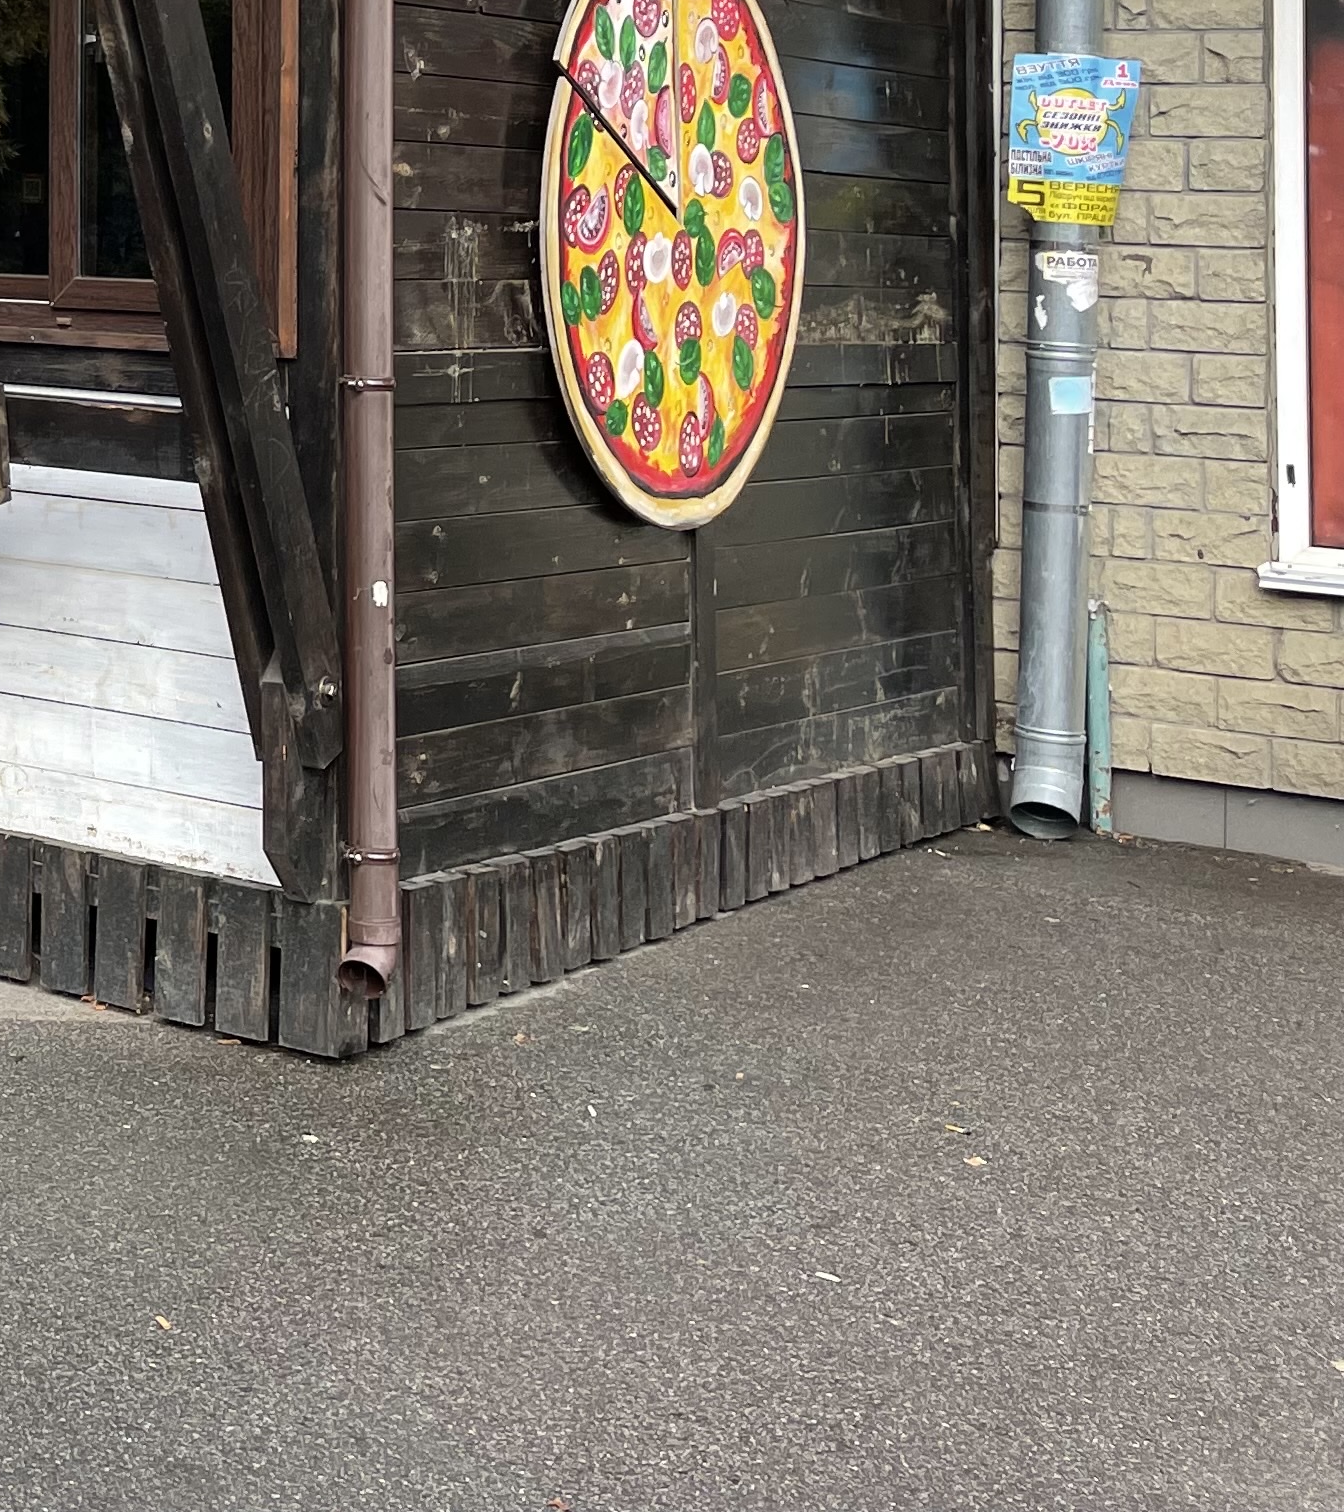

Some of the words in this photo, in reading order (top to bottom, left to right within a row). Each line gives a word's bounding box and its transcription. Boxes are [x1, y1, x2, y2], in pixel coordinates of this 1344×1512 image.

[1015, 57, 1081, 75] ВЗУТТЯ
[1117, 64, 1128, 78] 1
[1041, 96, 1107, 111] OUTLET
[1039, 121, 1102, 132] ЗНИЖКИ
[1040, 133, 1097, 152] -70%
[1010, 162, 1042, 176] БІЛИЗНА
[1016, 179, 1045, 206] 5
[1046, 255, 1098, 268] РАБОТА
